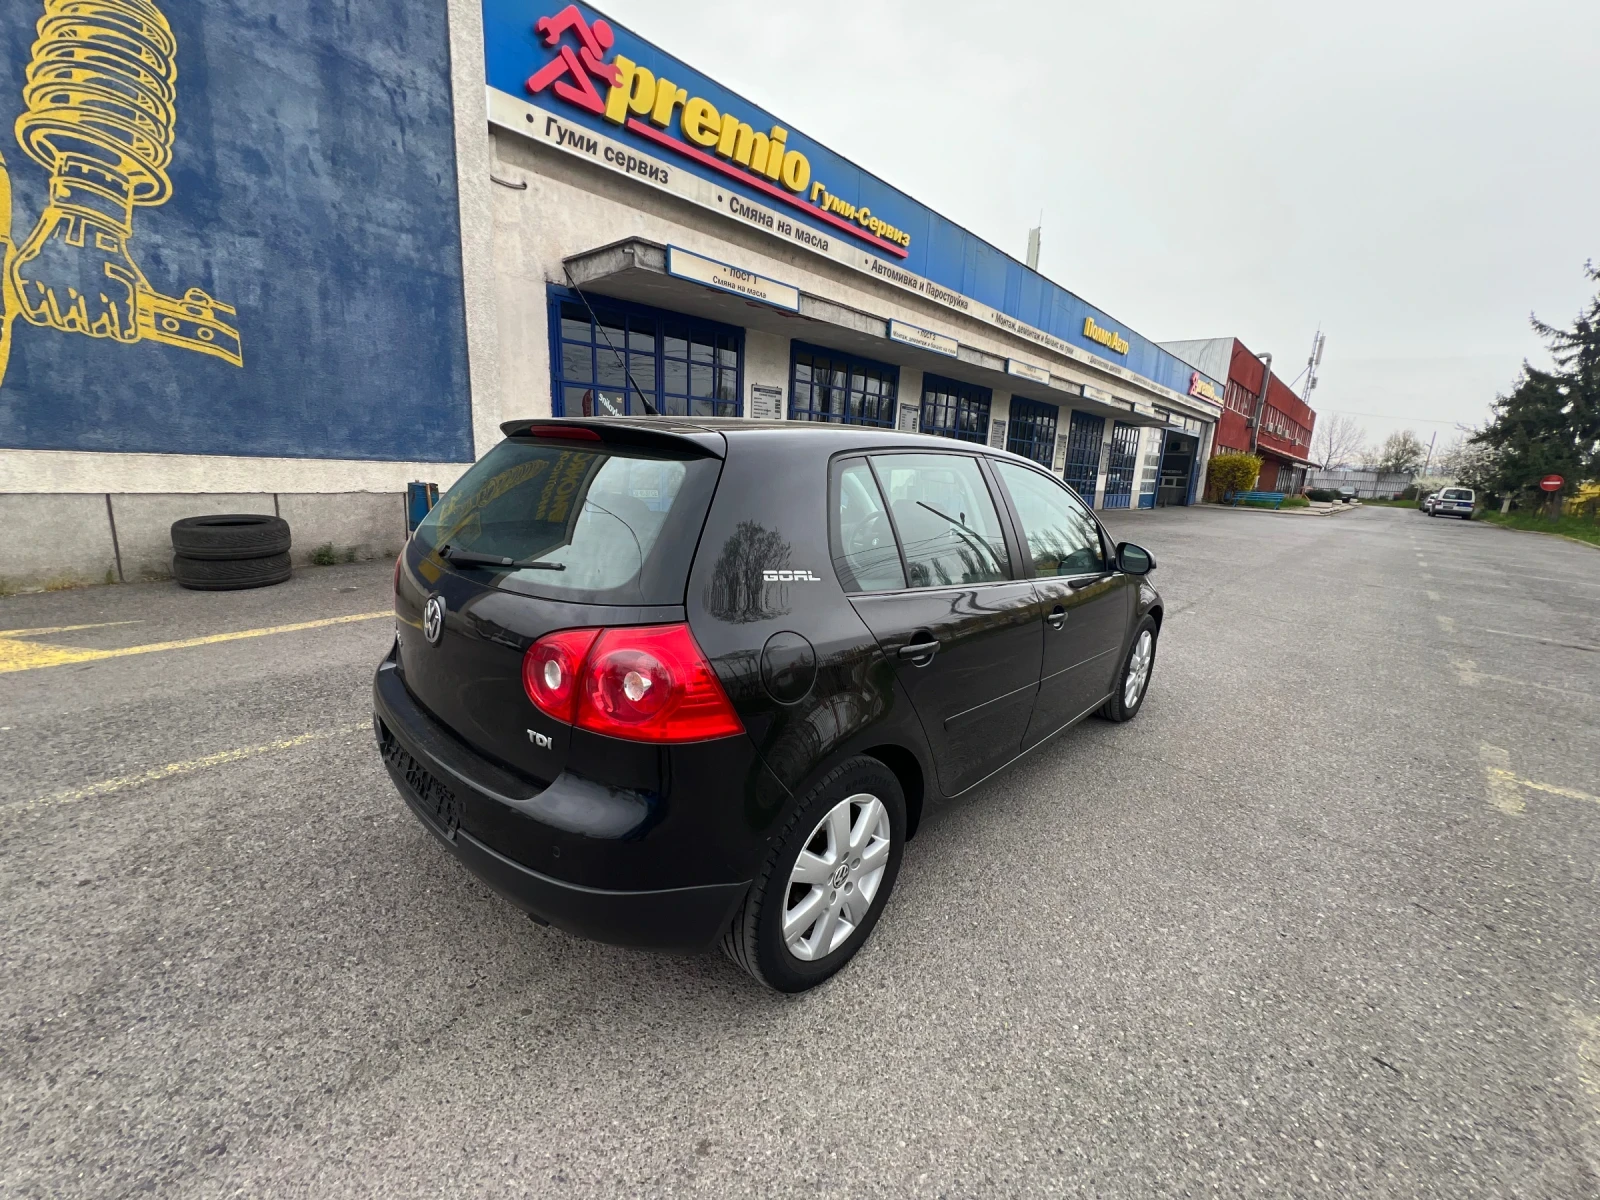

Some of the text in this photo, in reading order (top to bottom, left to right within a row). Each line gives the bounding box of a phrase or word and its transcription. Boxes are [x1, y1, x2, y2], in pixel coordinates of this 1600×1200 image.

[545, 116, 669, 184] Гуми сервиз
[604, 54, 811, 193] premio
[729, 196, 829, 252] Смяна на масла
[809, 181, 911, 248] Гуми-Сервиз
[712, 275, 767, 298] Смяна на масла
[871, 259, 968, 310] Автомивка и Пароструйка
[763, 570, 821, 581] GOAL
[526, 728, 552, 750] TDI
